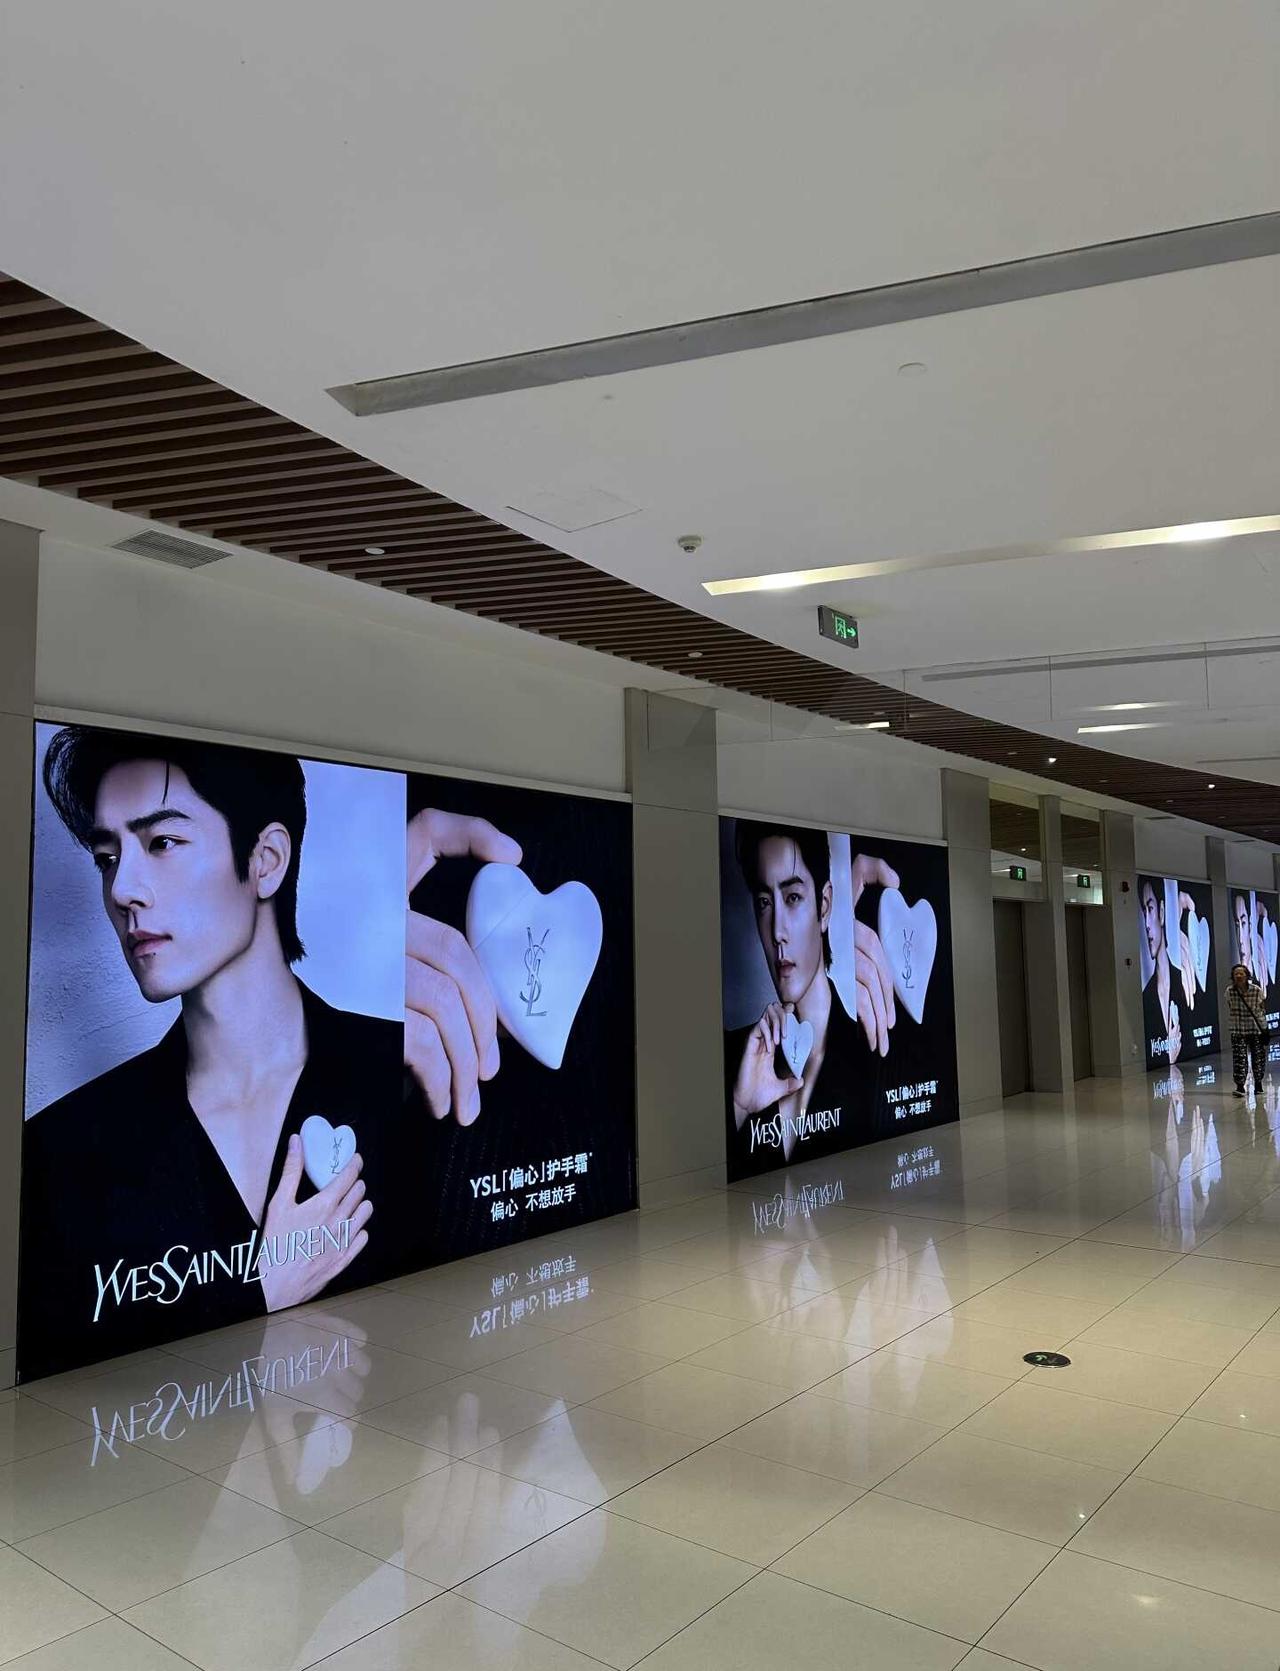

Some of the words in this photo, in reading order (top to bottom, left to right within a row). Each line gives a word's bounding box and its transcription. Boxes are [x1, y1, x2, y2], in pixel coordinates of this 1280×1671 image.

[490, 1198, 519, 1222] 偏心
[525, 1183, 577, 1212] 不想放手
